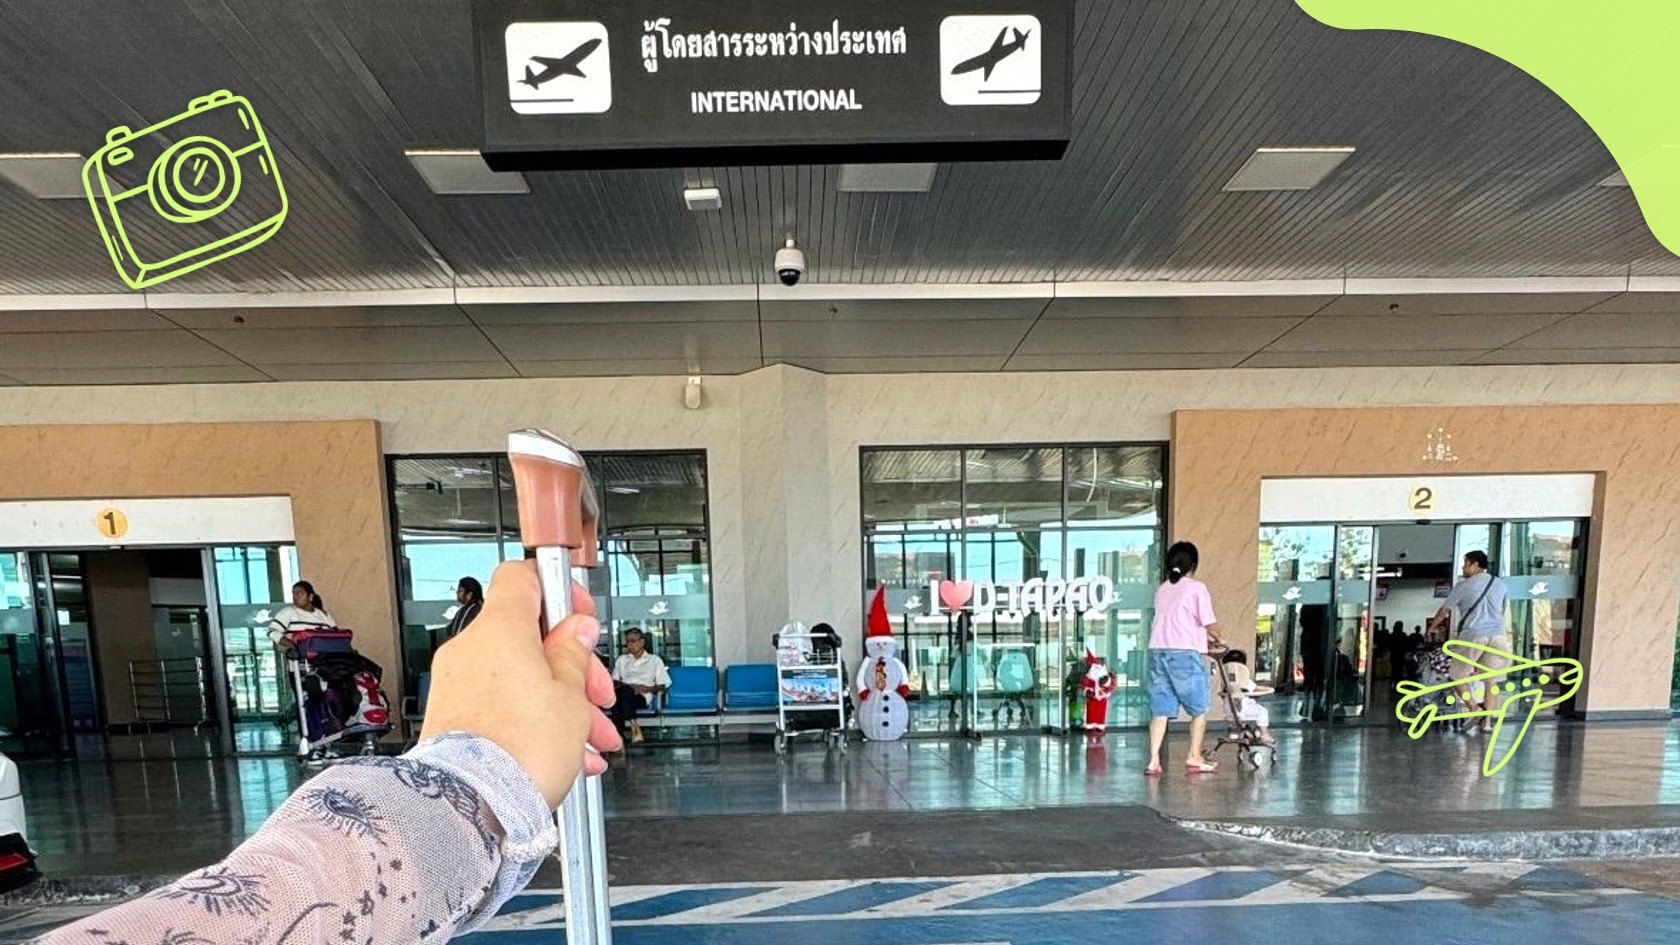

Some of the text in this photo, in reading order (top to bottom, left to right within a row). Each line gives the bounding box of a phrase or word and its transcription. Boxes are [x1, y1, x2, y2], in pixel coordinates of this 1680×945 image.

[641, 18, 907, 72] ผู้โดยสารระหว่างประเทศ
[691, 89, 862, 113] INTERNATIONAL
[1414, 487, 1432, 509] 2
[103, 511, 116, 535] 1
